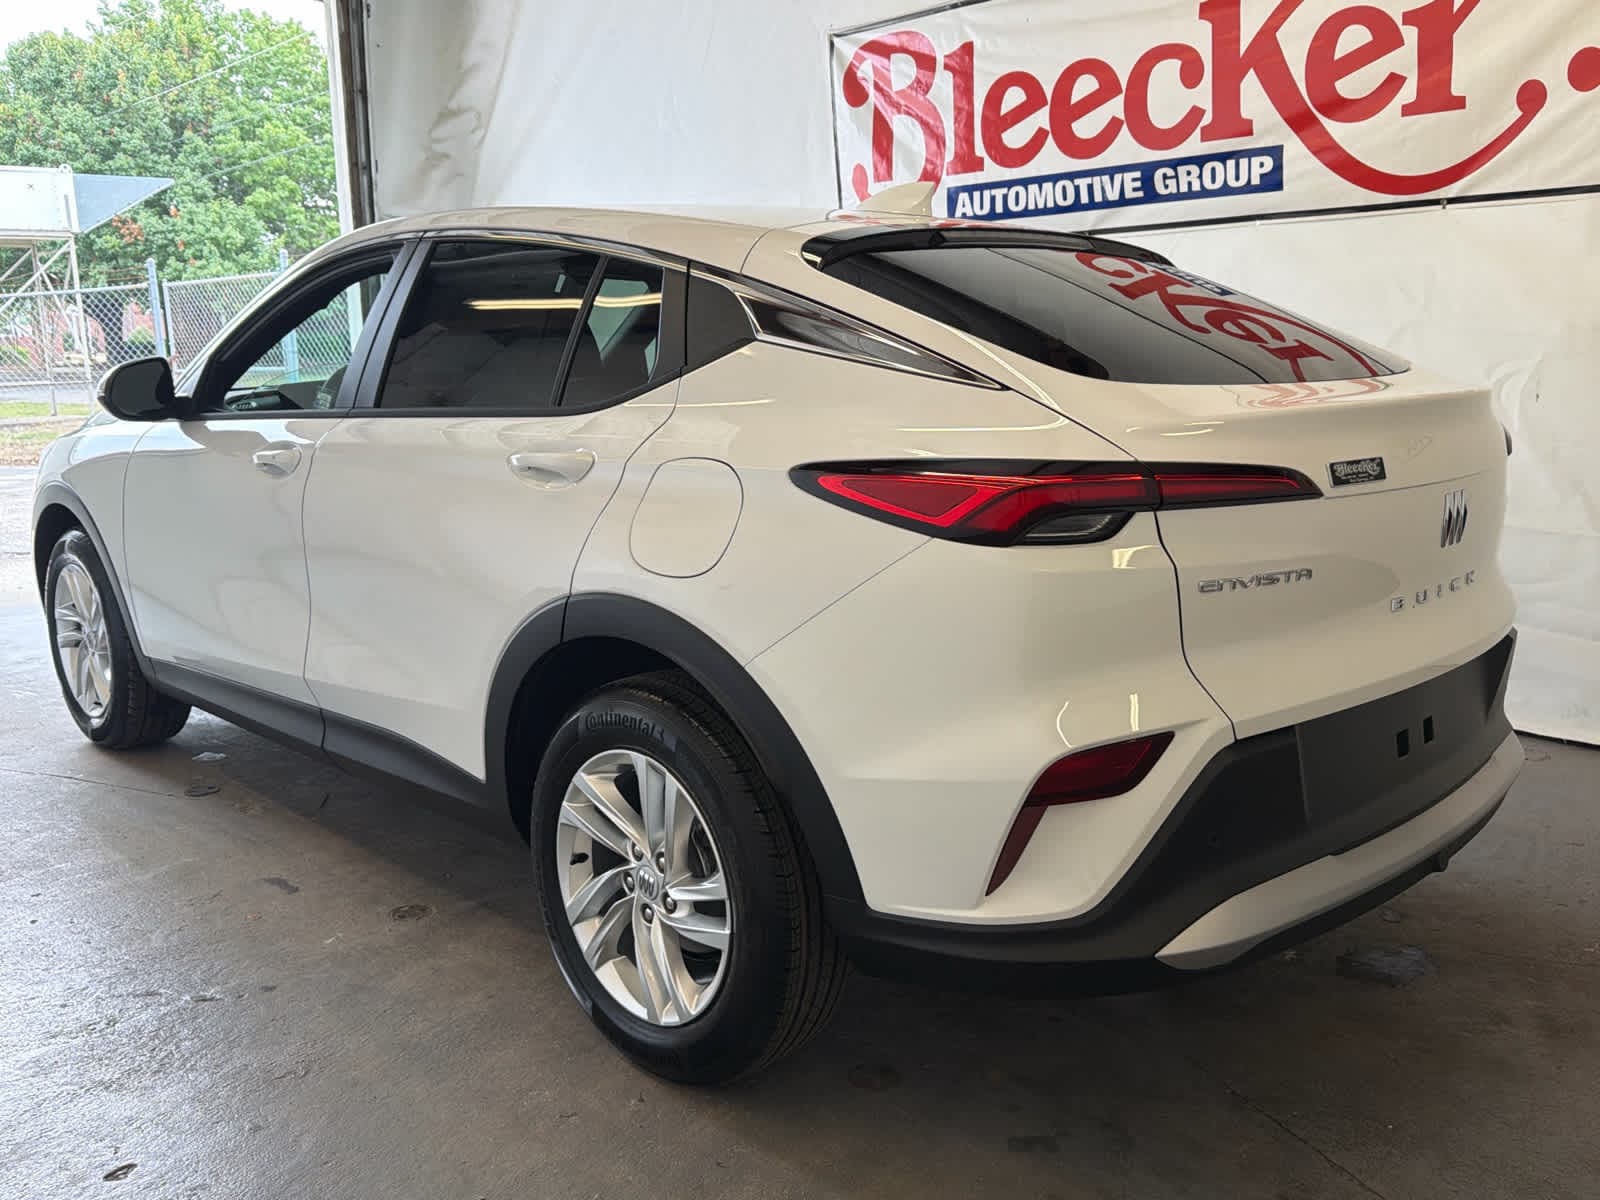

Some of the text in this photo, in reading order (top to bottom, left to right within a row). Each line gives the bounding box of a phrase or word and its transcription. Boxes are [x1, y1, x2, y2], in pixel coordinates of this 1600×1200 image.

[954, 155, 1275, 219] AUTOMOTIVE GROUP
[1198, 568, 1313, 593] ENVISTA
[1391, 569, 1476, 613] BUICK
